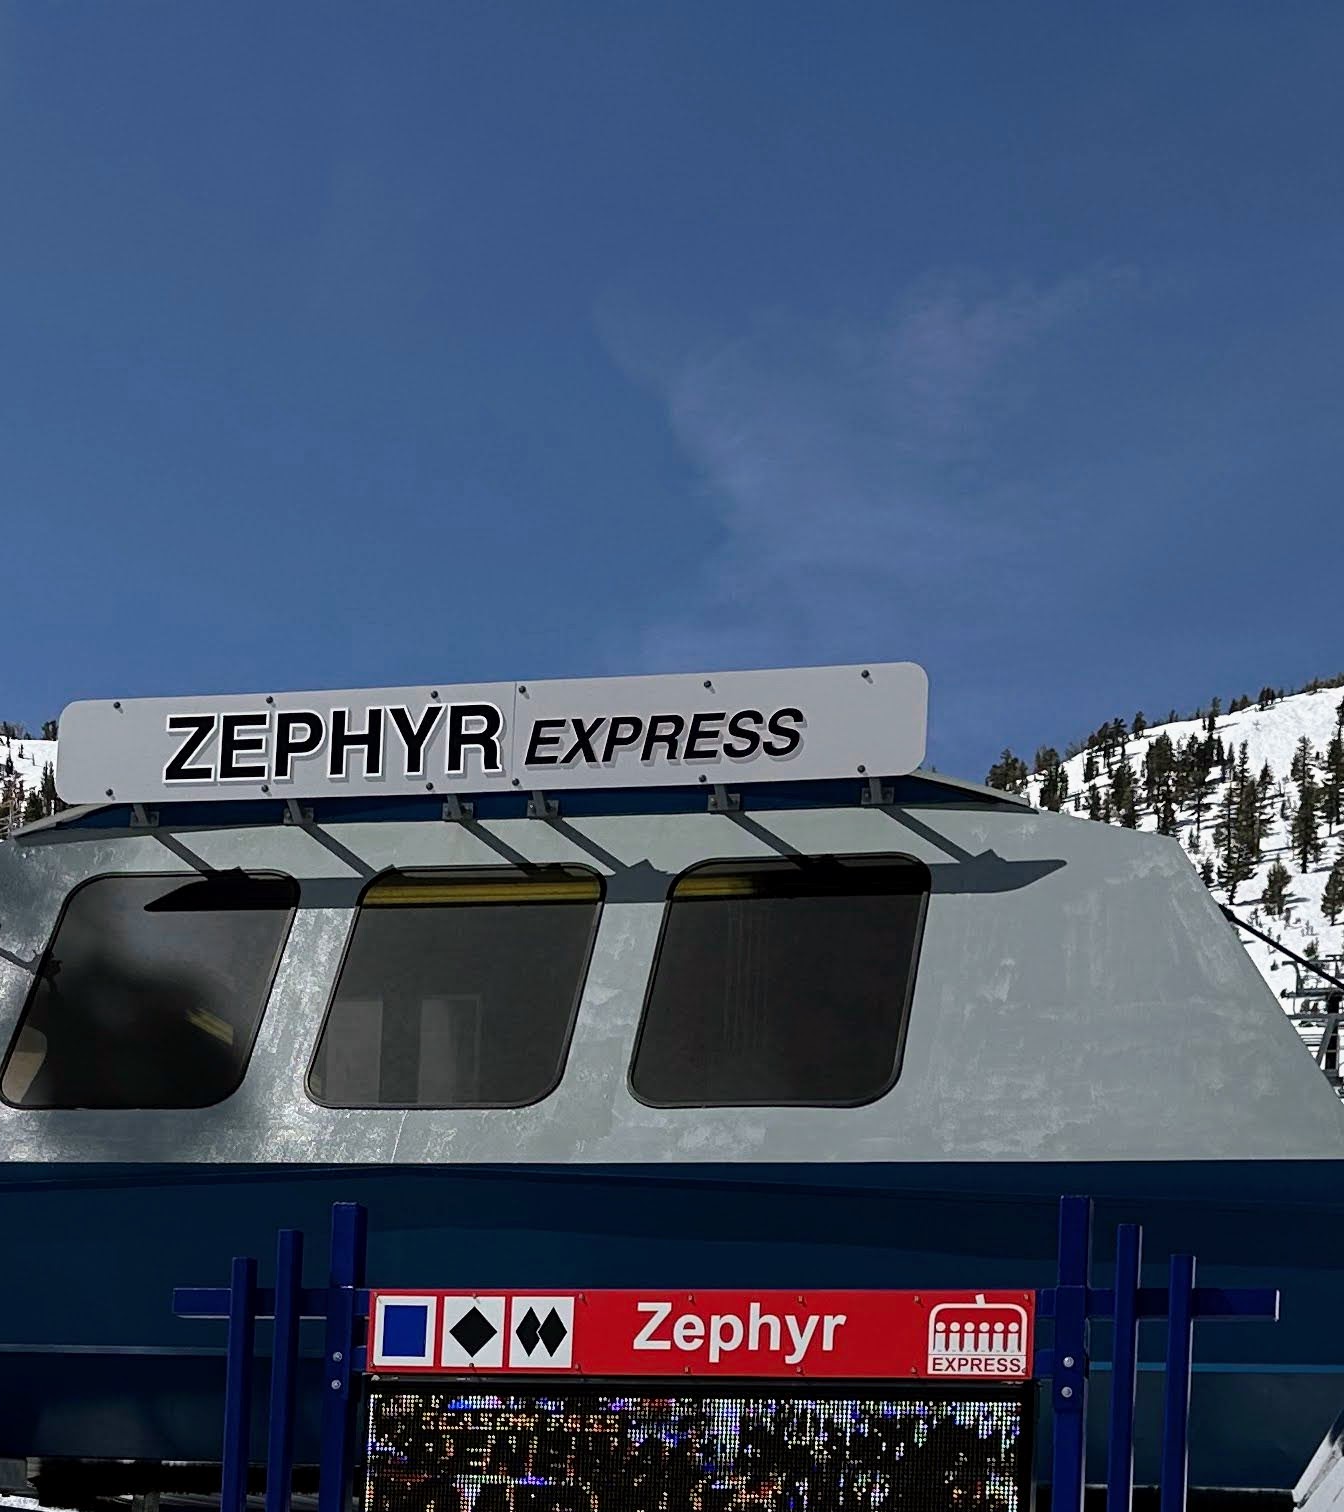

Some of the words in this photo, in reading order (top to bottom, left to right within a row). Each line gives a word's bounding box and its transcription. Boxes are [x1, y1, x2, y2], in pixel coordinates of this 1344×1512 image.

[164, 701, 507, 782] ZEPHYR
[524, 708, 804, 766] EXPRESS
[633, 1302, 846, 1364] Zephyr
[932, 1356, 1021, 1373] EXPRESS
